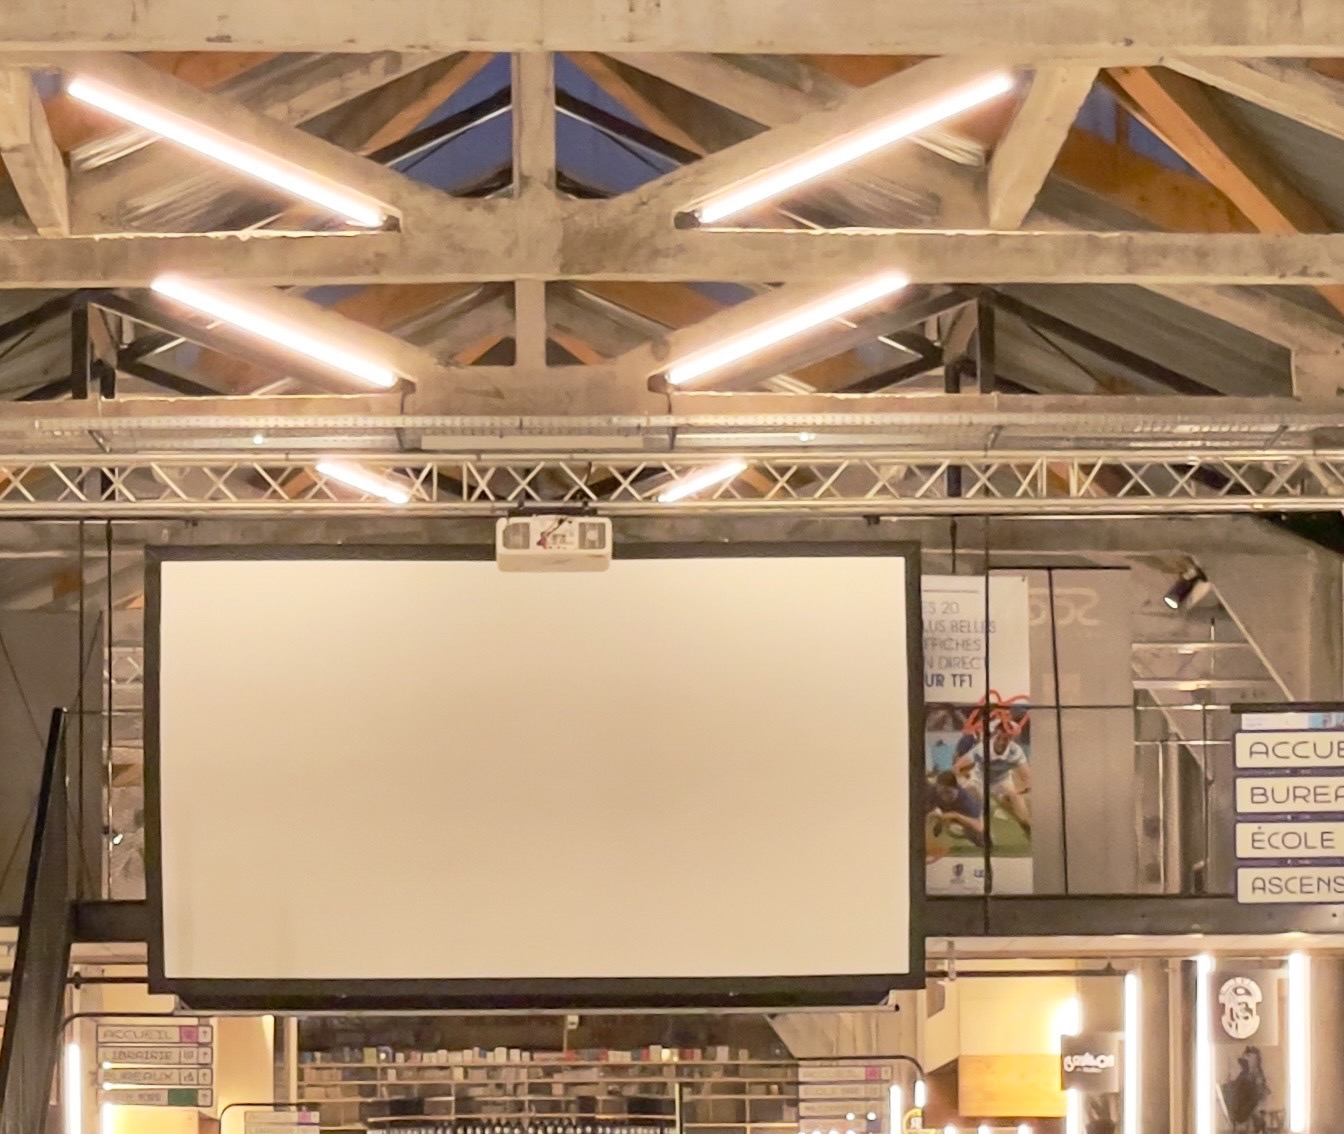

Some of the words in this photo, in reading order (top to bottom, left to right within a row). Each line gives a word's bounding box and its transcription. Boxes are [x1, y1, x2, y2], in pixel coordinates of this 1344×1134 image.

[951, 673, 973, 688] TF1
[1251, 826, 1335, 850] ÉCOLE
[103, 1029, 173, 1040] ACCUEIL
